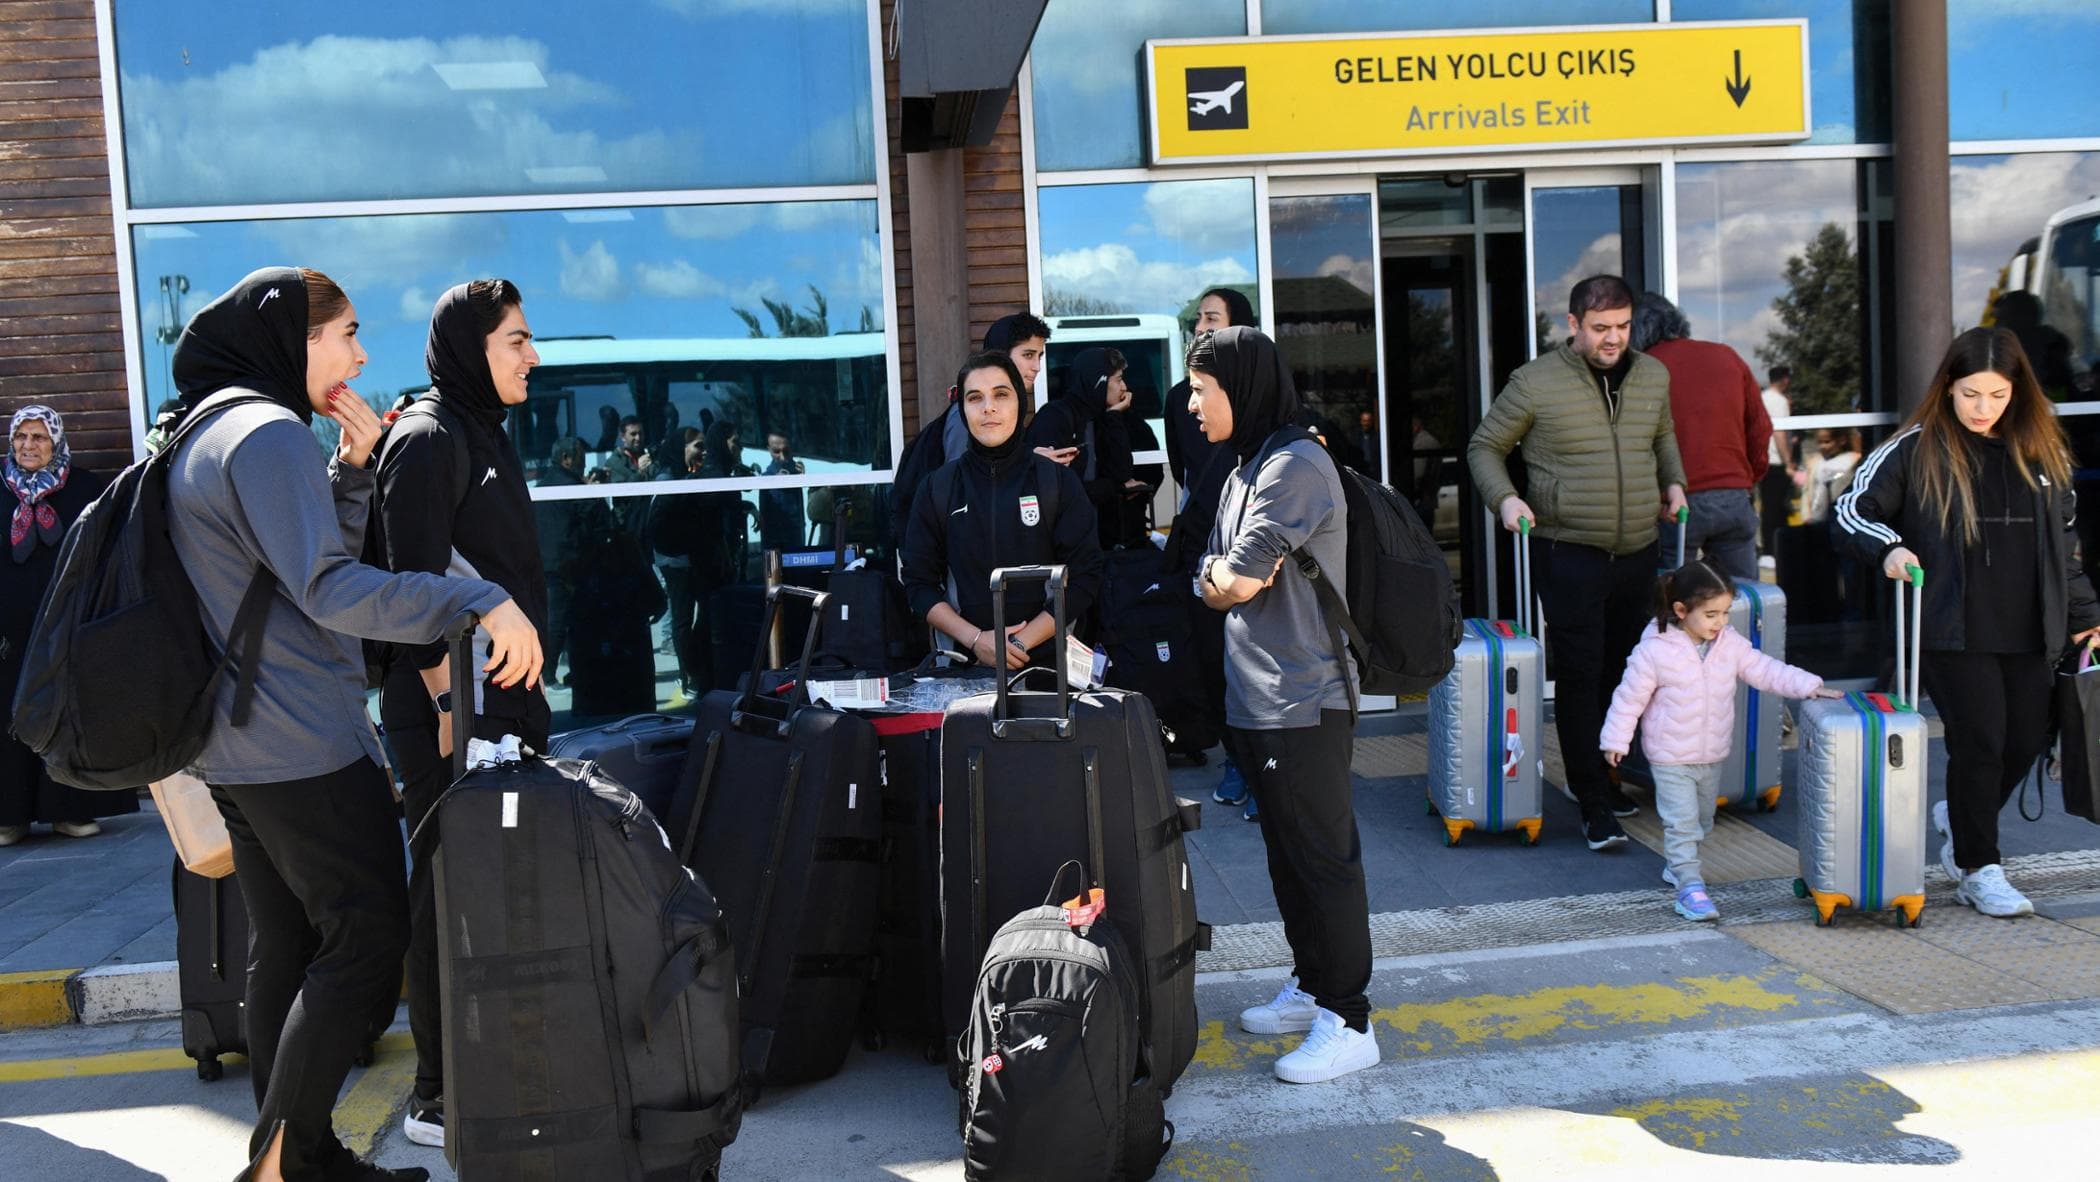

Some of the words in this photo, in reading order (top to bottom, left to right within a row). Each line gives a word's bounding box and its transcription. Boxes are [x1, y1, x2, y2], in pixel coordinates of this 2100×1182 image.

[1334, 56, 1437, 84] GELEN
[1447, 51, 1547, 80] YOLCU
[1557, 48, 1636, 80] ÇIKIŞ
[1405, 102, 1526, 131] Arrivals
[1535, 100, 1591, 126] Exit
